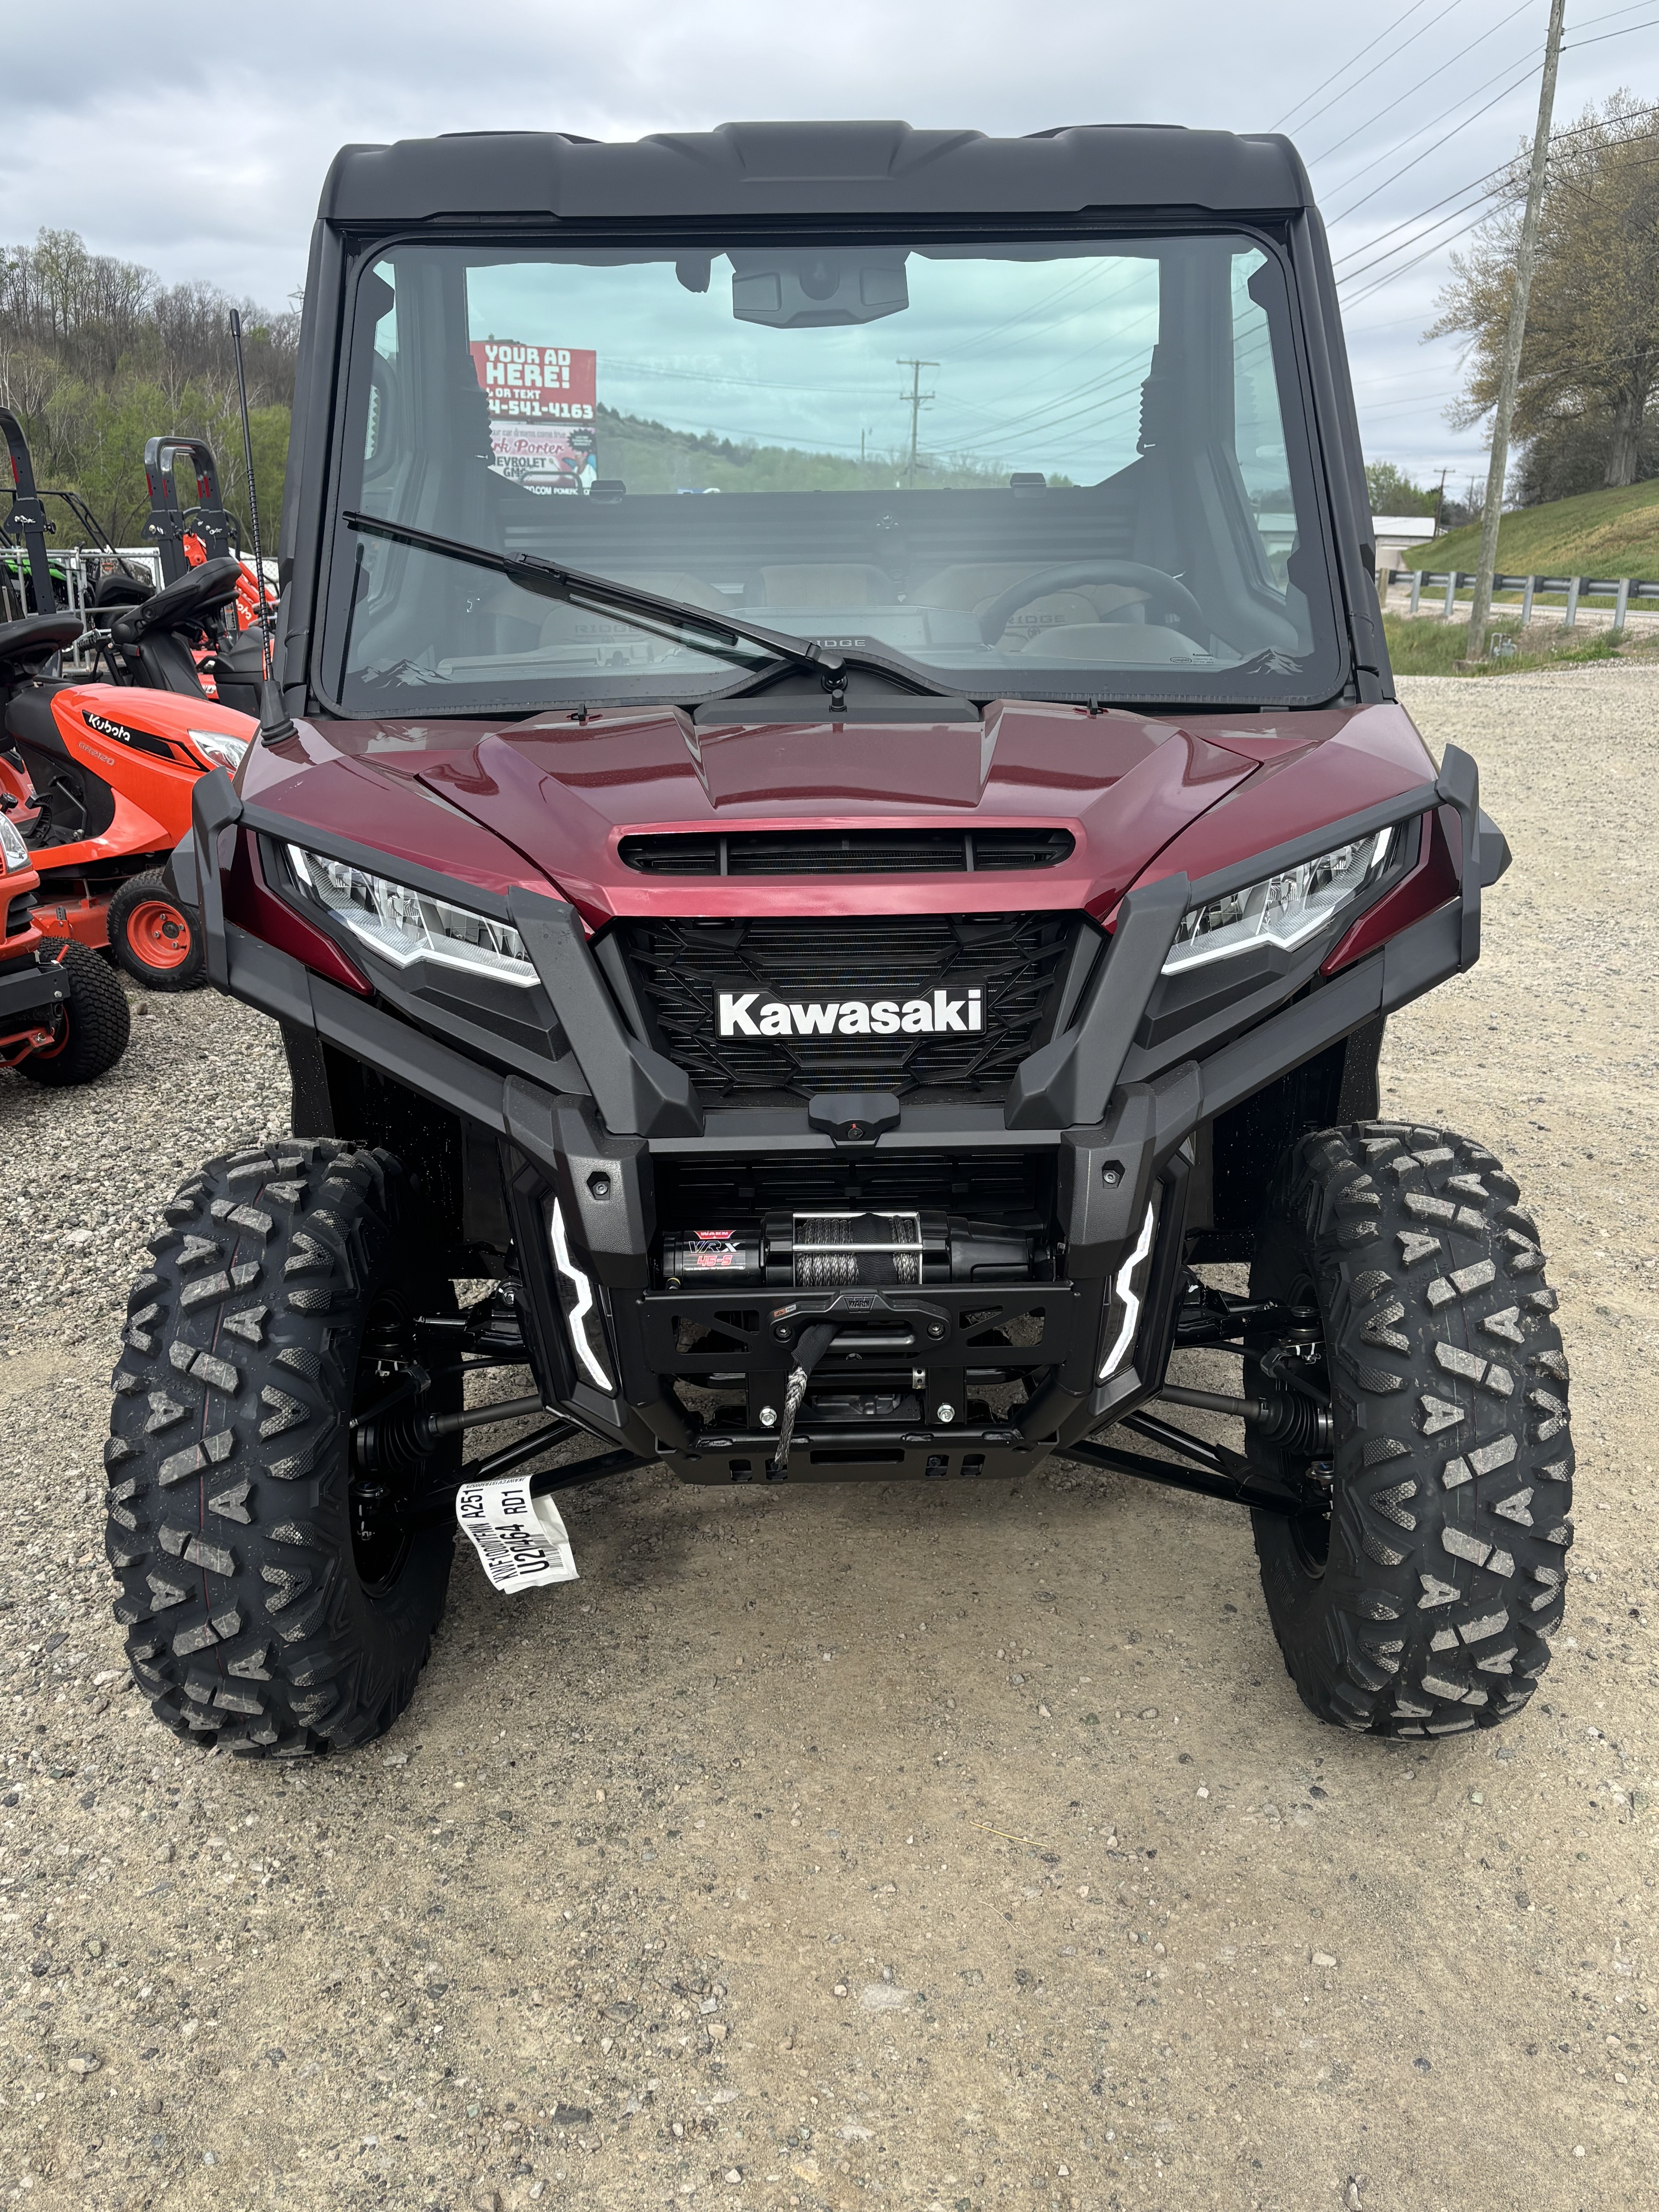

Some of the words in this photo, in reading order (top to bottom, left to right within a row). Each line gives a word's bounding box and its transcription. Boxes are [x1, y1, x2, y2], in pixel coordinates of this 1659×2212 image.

[485, 345, 539, 364] YOUR
[544, 349, 570, 366] AD
[486, 362, 570, 388] HERE!
[495, 388, 511, 398] OR
[513, 389, 541, 400] TEXT
[488, 399, 593, 419] 4-541-4163
[492, 438, 512, 453] rk
[514, 439, 564, 454] Porter
[494, 456, 547, 468] EVROLET
[88, 714, 130, 742] Kubota
[719, 989, 981, 1036] Kawasaki
[688, 1240, 741, 1254] VRX
[697, 1255, 733, 1267] 45-S
[460, 1488, 486, 1518] A251
[501, 1489, 528, 1515] RD1
[495, 1524, 550, 1575] U20464
